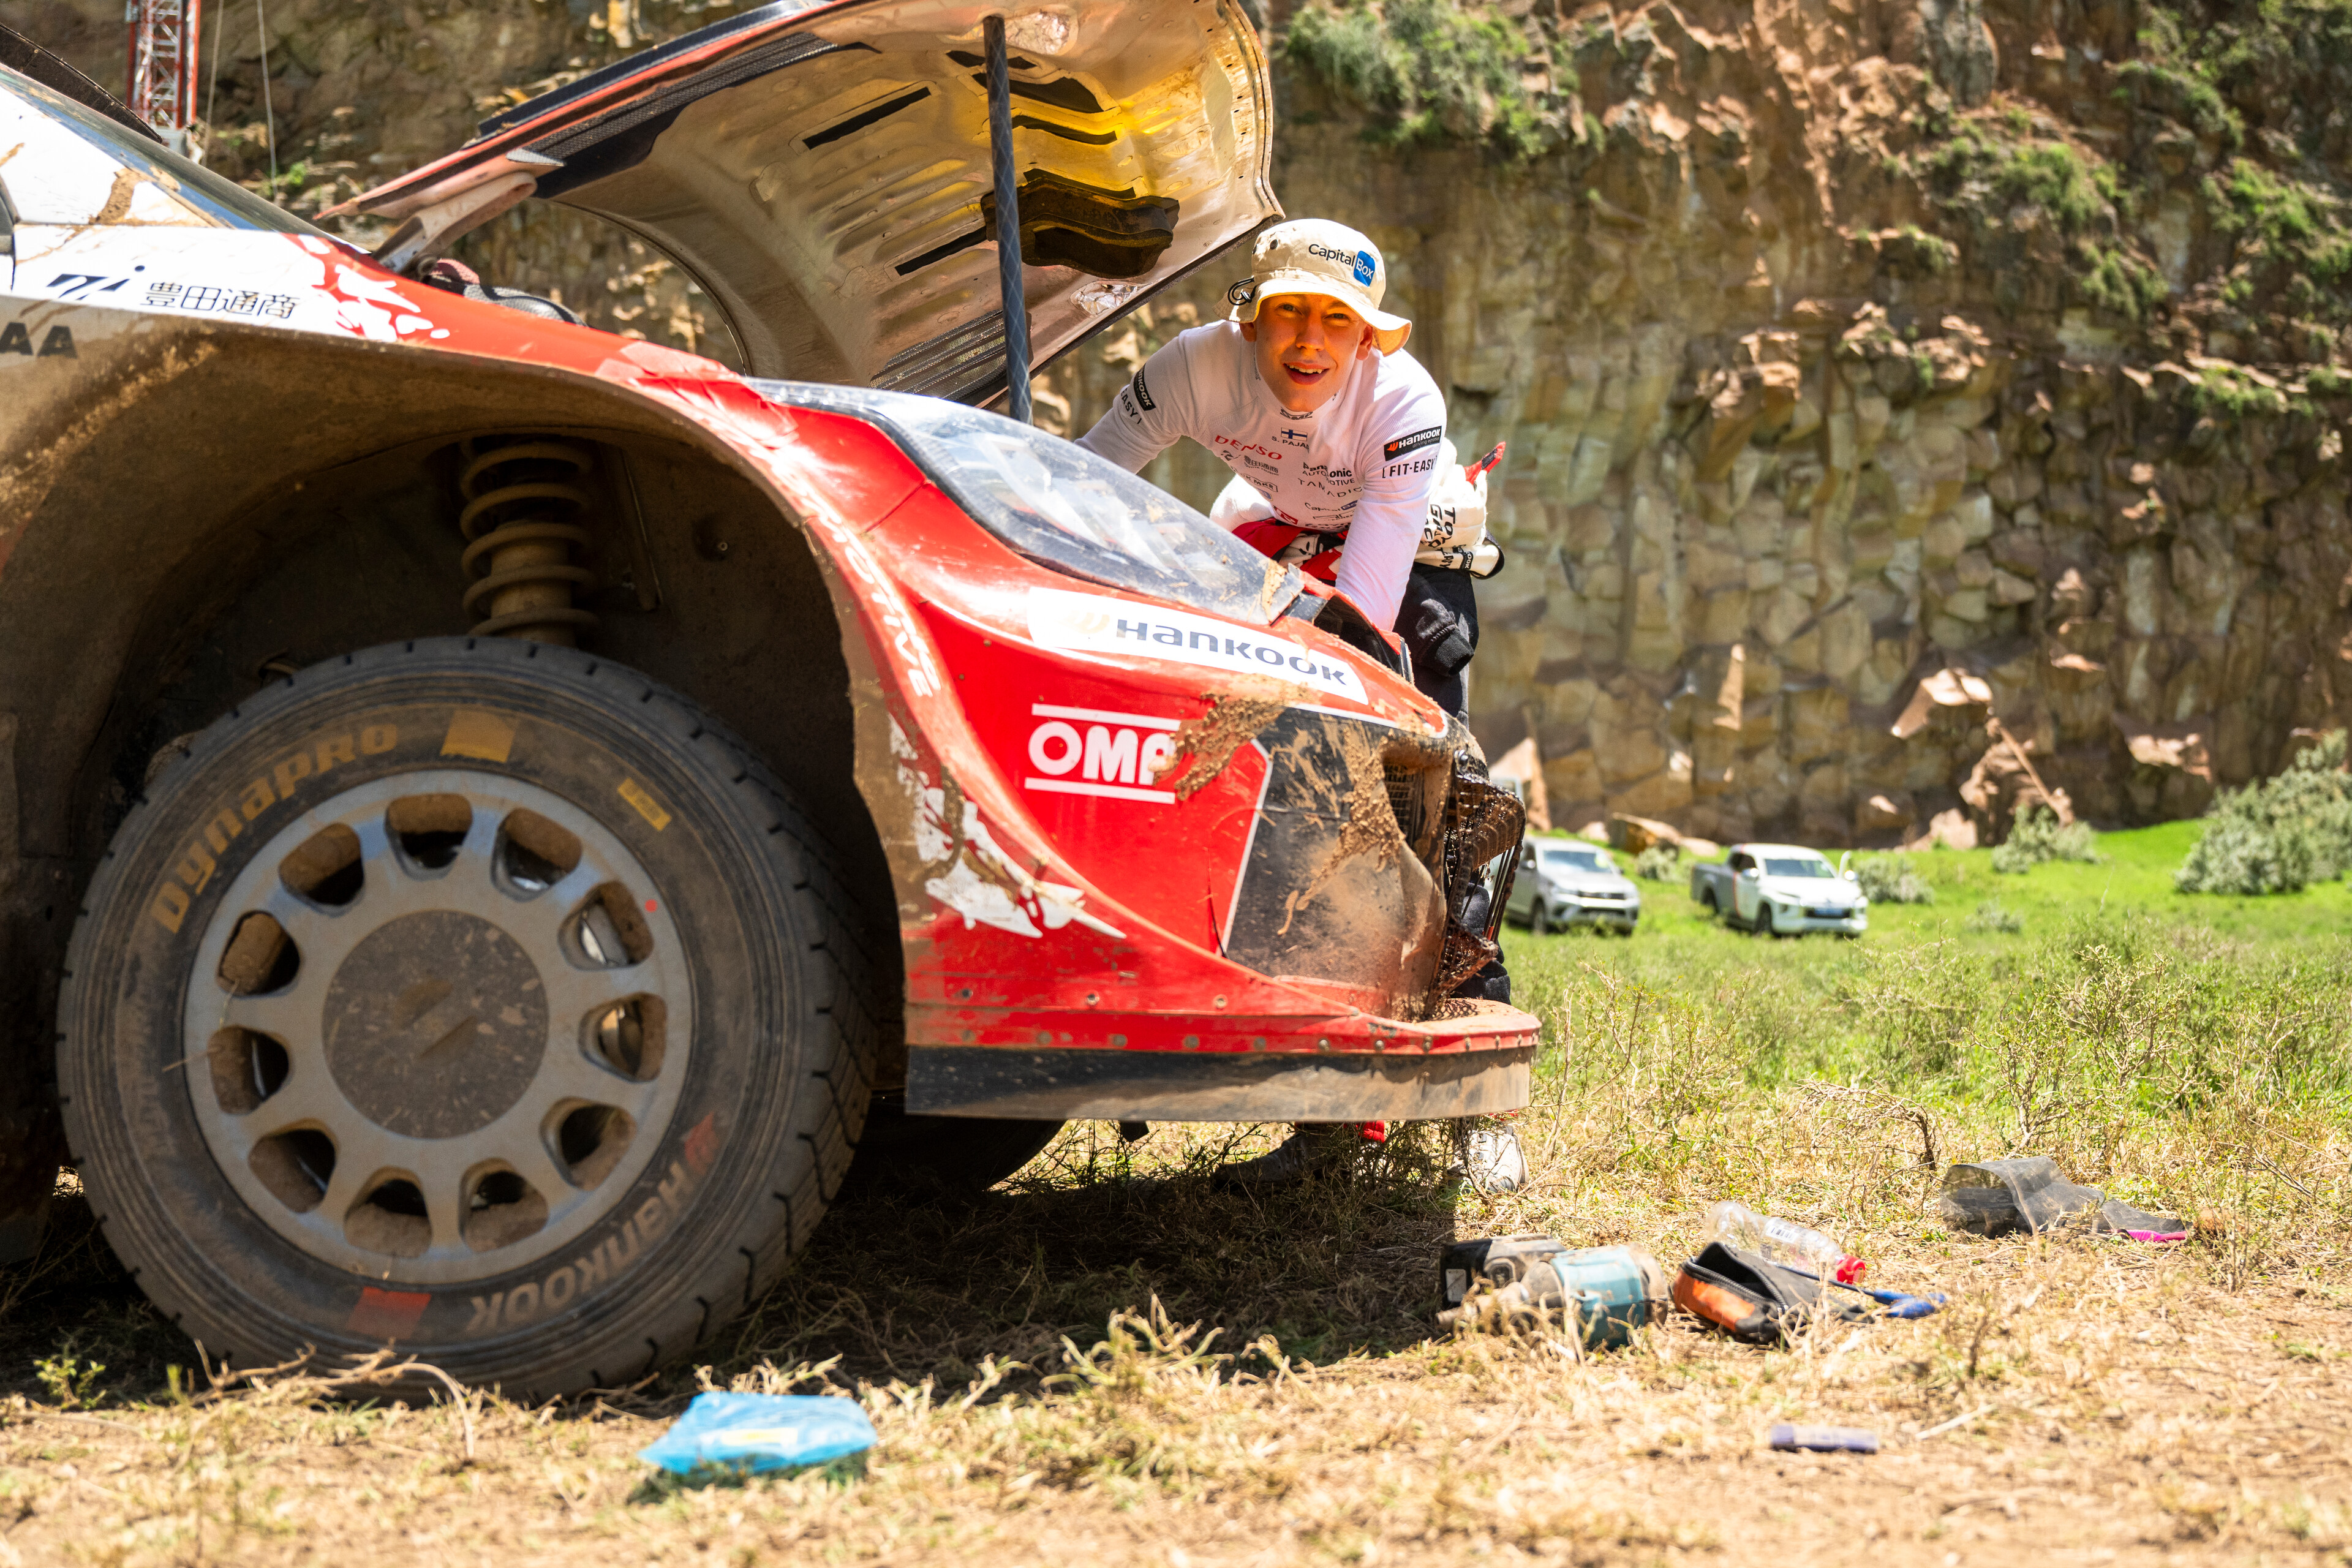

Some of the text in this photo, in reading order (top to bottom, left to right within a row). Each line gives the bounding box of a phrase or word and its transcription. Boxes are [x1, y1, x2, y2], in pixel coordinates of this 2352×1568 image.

[140, 282, 300, 319] 豊田通商
[1215, 435, 1283, 460] DENSO
[1303, 462, 1352, 478] Panaonic
